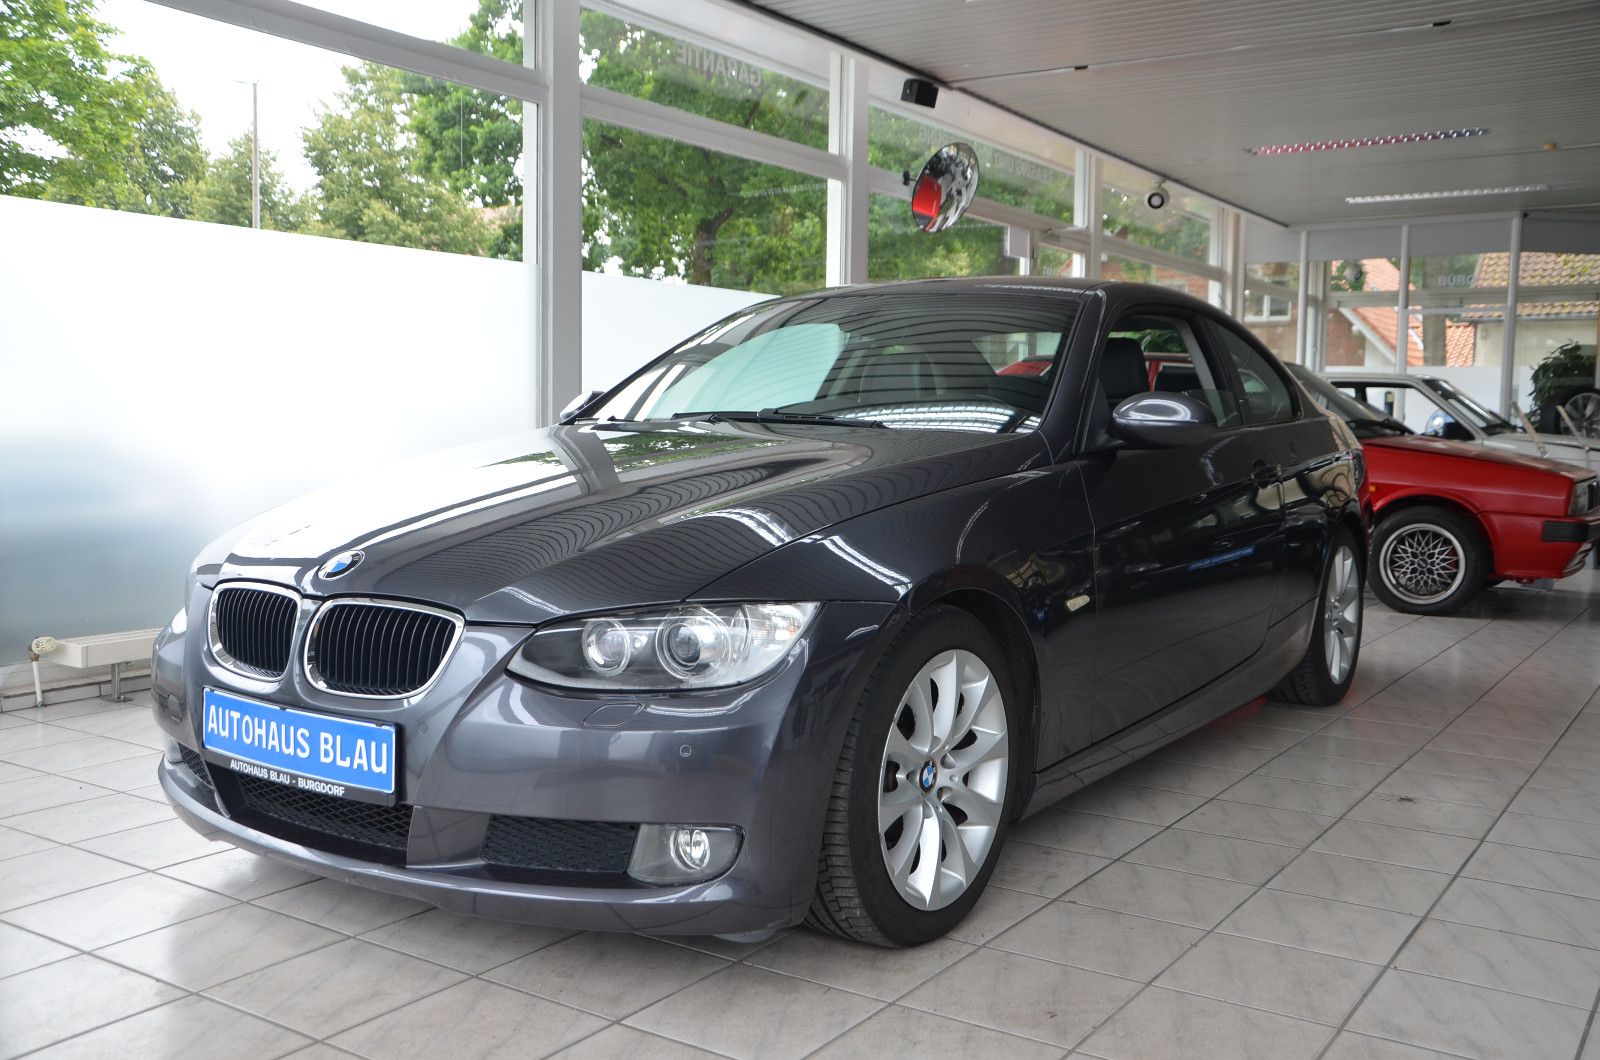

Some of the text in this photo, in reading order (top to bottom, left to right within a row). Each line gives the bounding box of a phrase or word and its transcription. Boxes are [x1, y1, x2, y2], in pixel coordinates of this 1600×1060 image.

[208, 704, 388, 775] AUTOHAUS BLAU
[230, 759, 268, 778] AUTOHAUS
[269, 770, 290, 785] BLAU
[297, 777, 345, 797] BURGDORF
